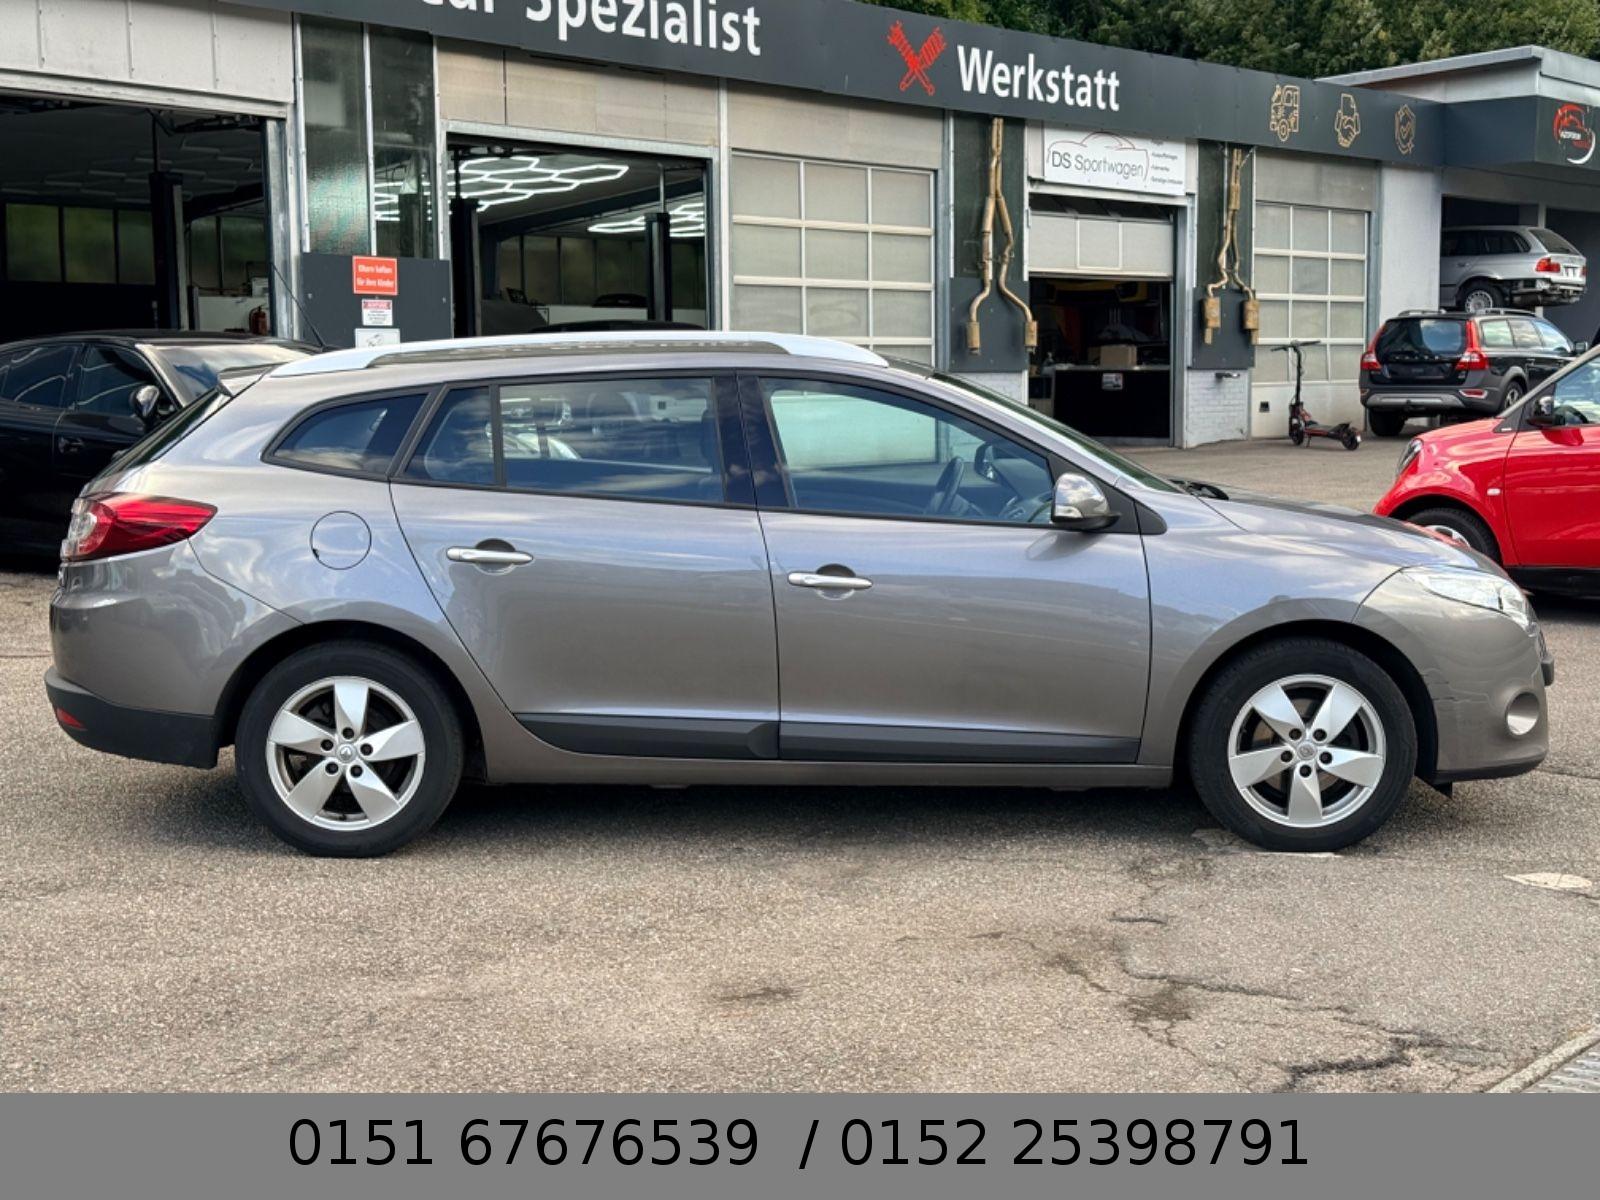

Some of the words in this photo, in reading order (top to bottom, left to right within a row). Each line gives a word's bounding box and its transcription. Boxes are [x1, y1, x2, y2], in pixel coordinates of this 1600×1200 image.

[526, 0, 761, 56] Spezialist
[957, 45, 1120, 112] Werkstatt
[1051, 150, 1071, 169] DS
[1074, 154, 1144, 180] Sportwagen
